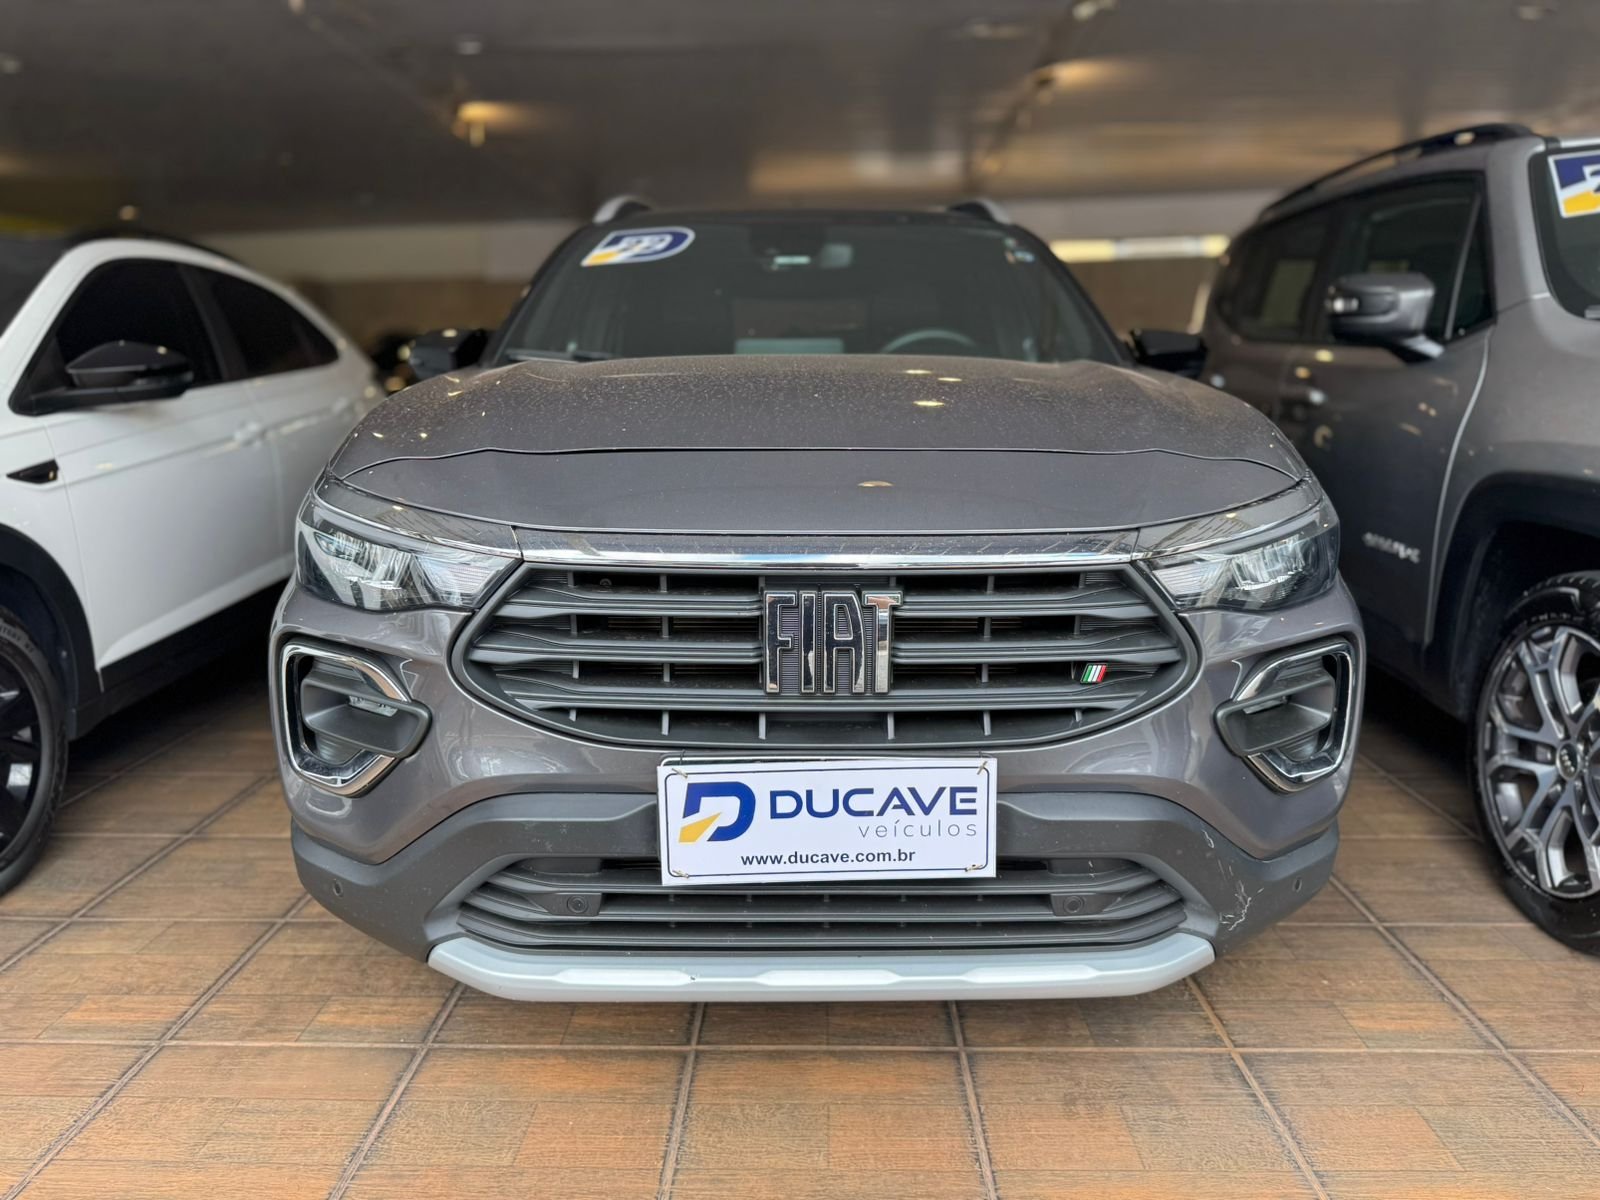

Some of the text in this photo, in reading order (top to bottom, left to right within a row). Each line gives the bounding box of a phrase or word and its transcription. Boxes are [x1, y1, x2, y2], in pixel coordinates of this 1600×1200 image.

[764, 591, 903, 694] FIAT
[769, 786, 978, 819] DUCAVE
[858, 819, 977, 838] veículos
[740, 848, 916, 866] www.ducave.com.br
